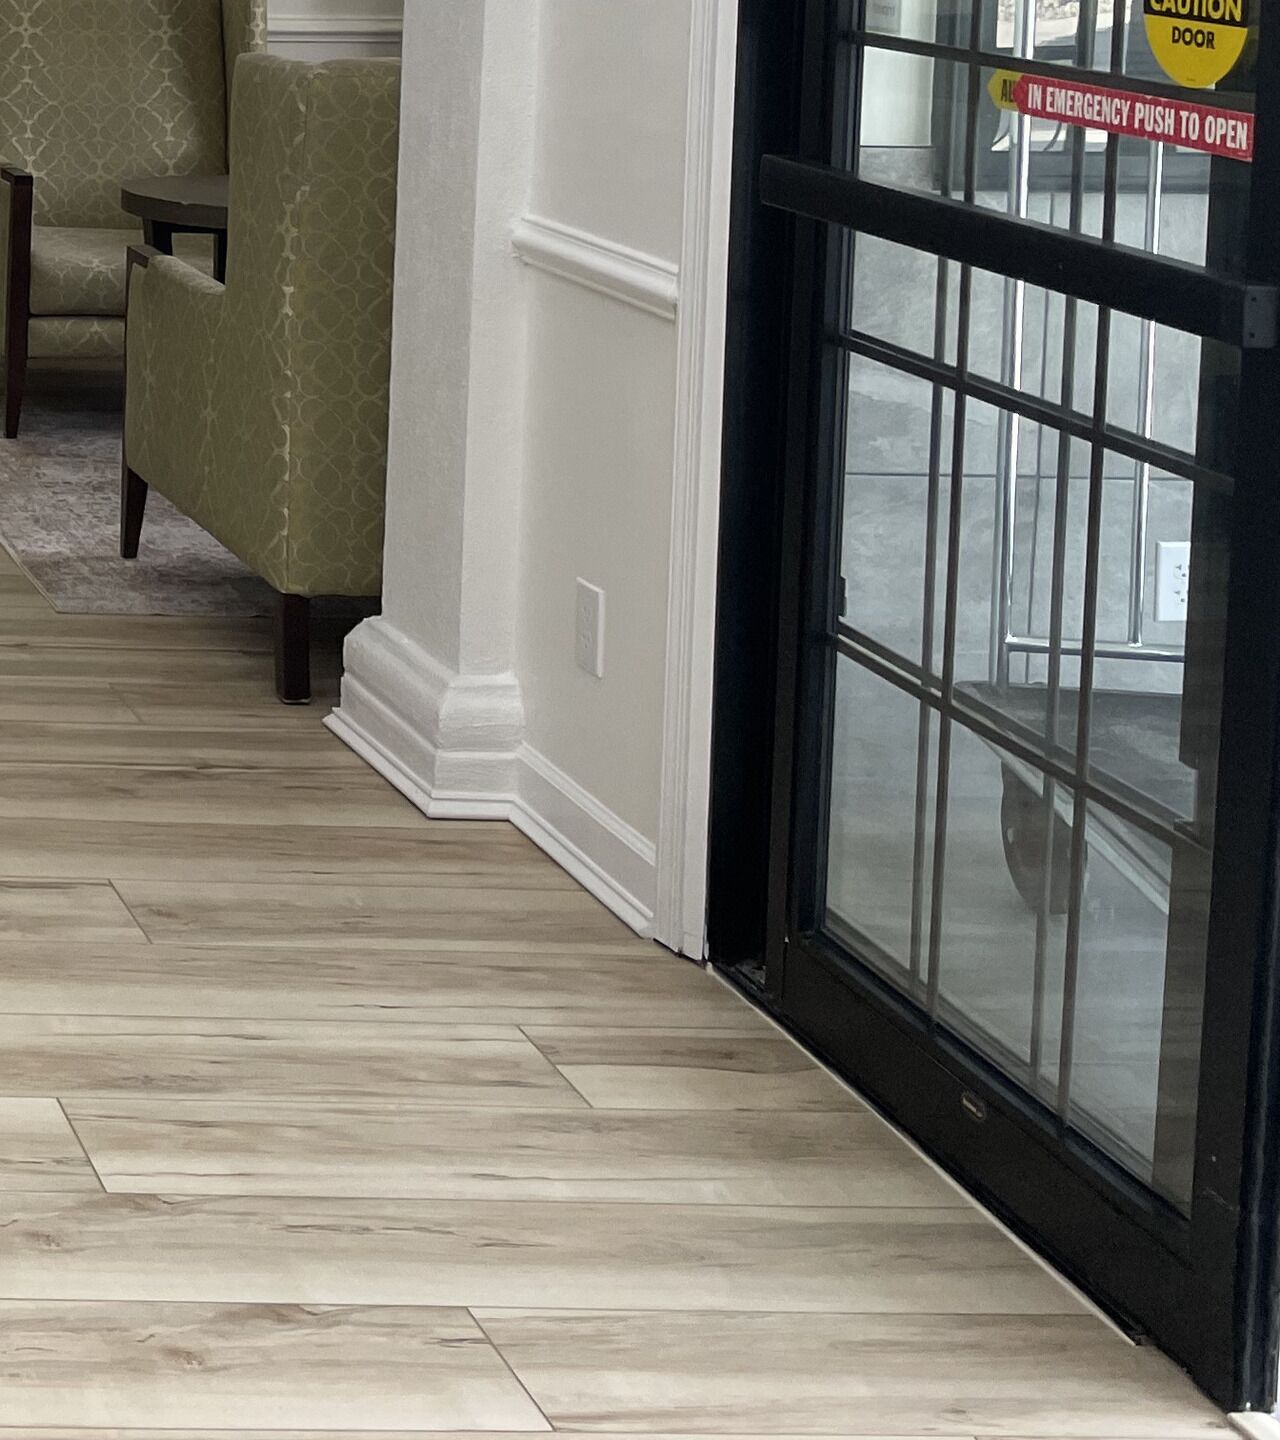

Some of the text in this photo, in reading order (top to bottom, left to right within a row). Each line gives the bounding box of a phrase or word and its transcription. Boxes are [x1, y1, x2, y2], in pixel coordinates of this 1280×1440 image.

[1171, 26, 1216, 50] DOOR
[1027, 83, 1042, 110] IN
[1045, 86, 1131, 127] EMERGENCY
[1134, 102, 1175, 136] PUSH
[1179, 110, 1200, 141] TO
[1204, 115, 1249, 151] OPEN
